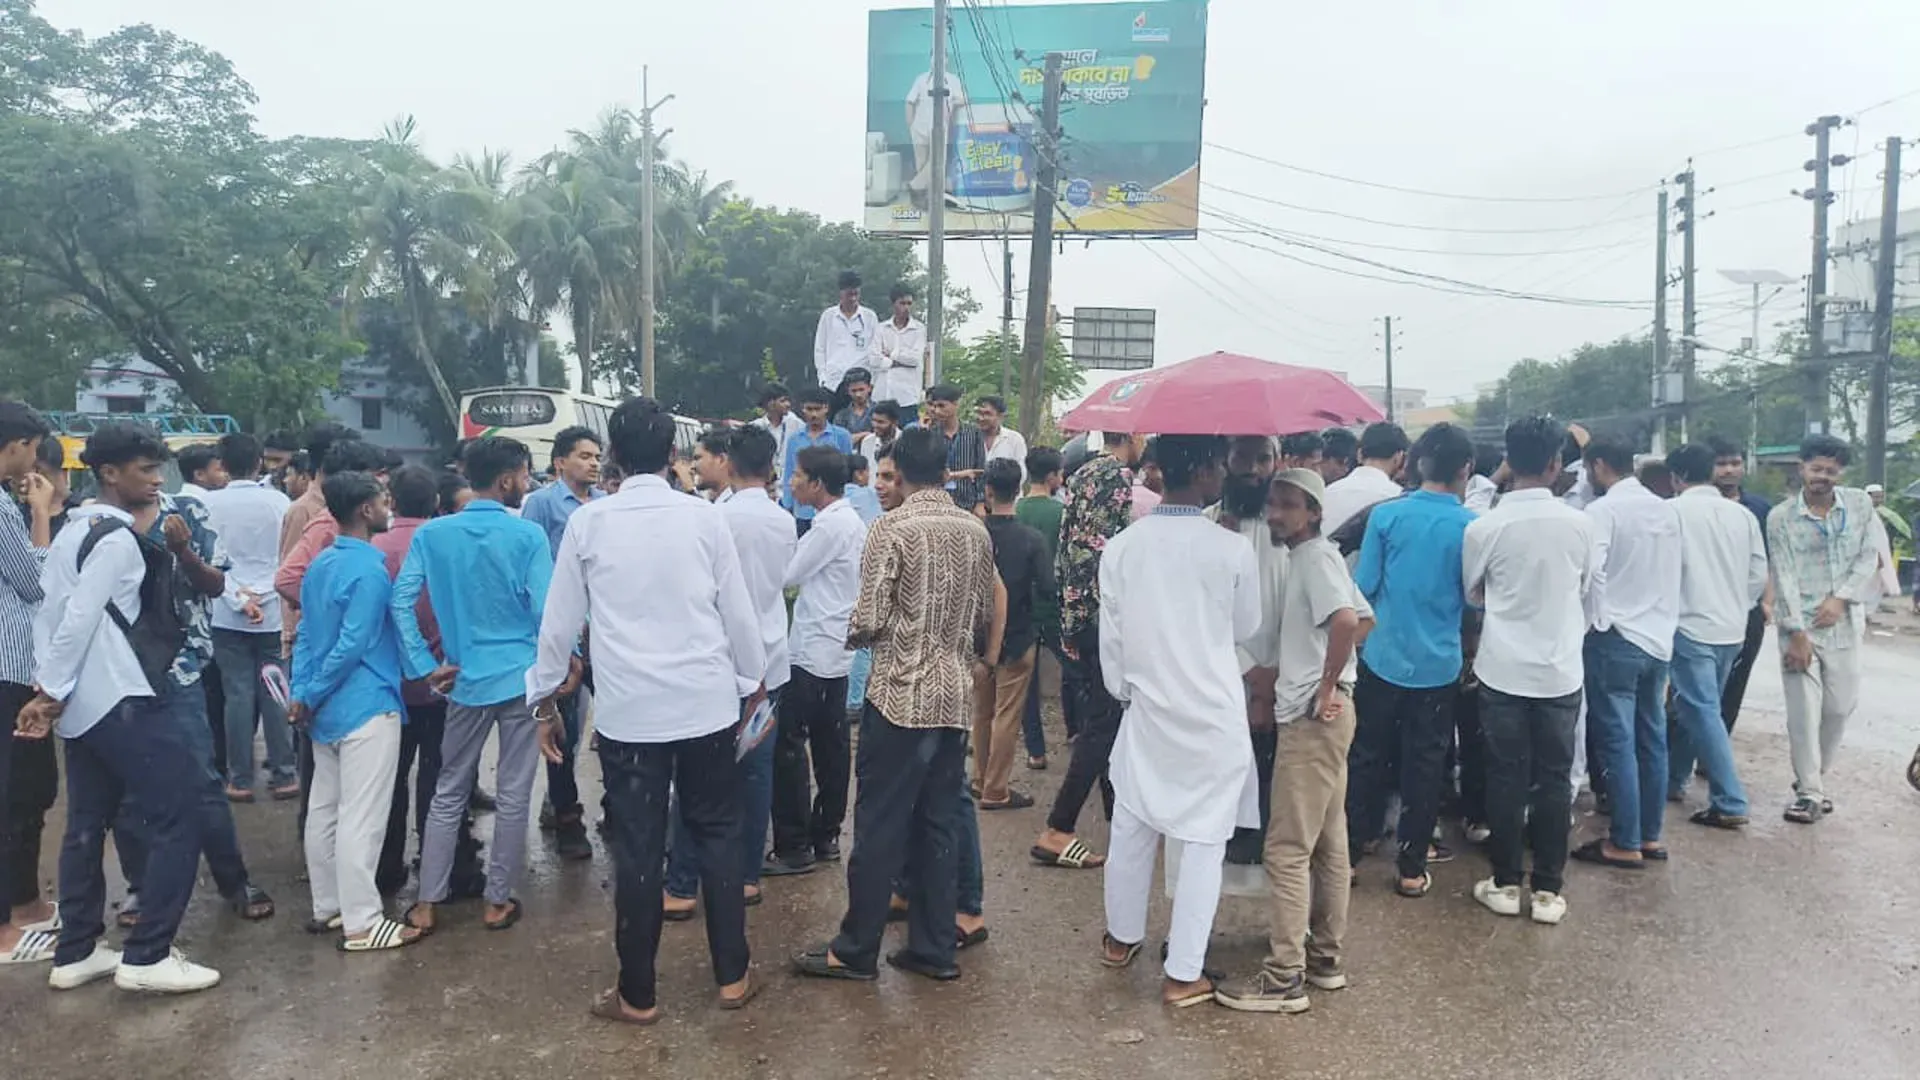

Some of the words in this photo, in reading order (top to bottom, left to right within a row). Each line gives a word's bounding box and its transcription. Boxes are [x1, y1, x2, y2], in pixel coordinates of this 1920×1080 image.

[1109, 67, 1129, 83] না
[966, 141, 1001, 158] Easy
[970, 154, 1012, 172] Clean
[480, 404, 540, 415] SAKURA
